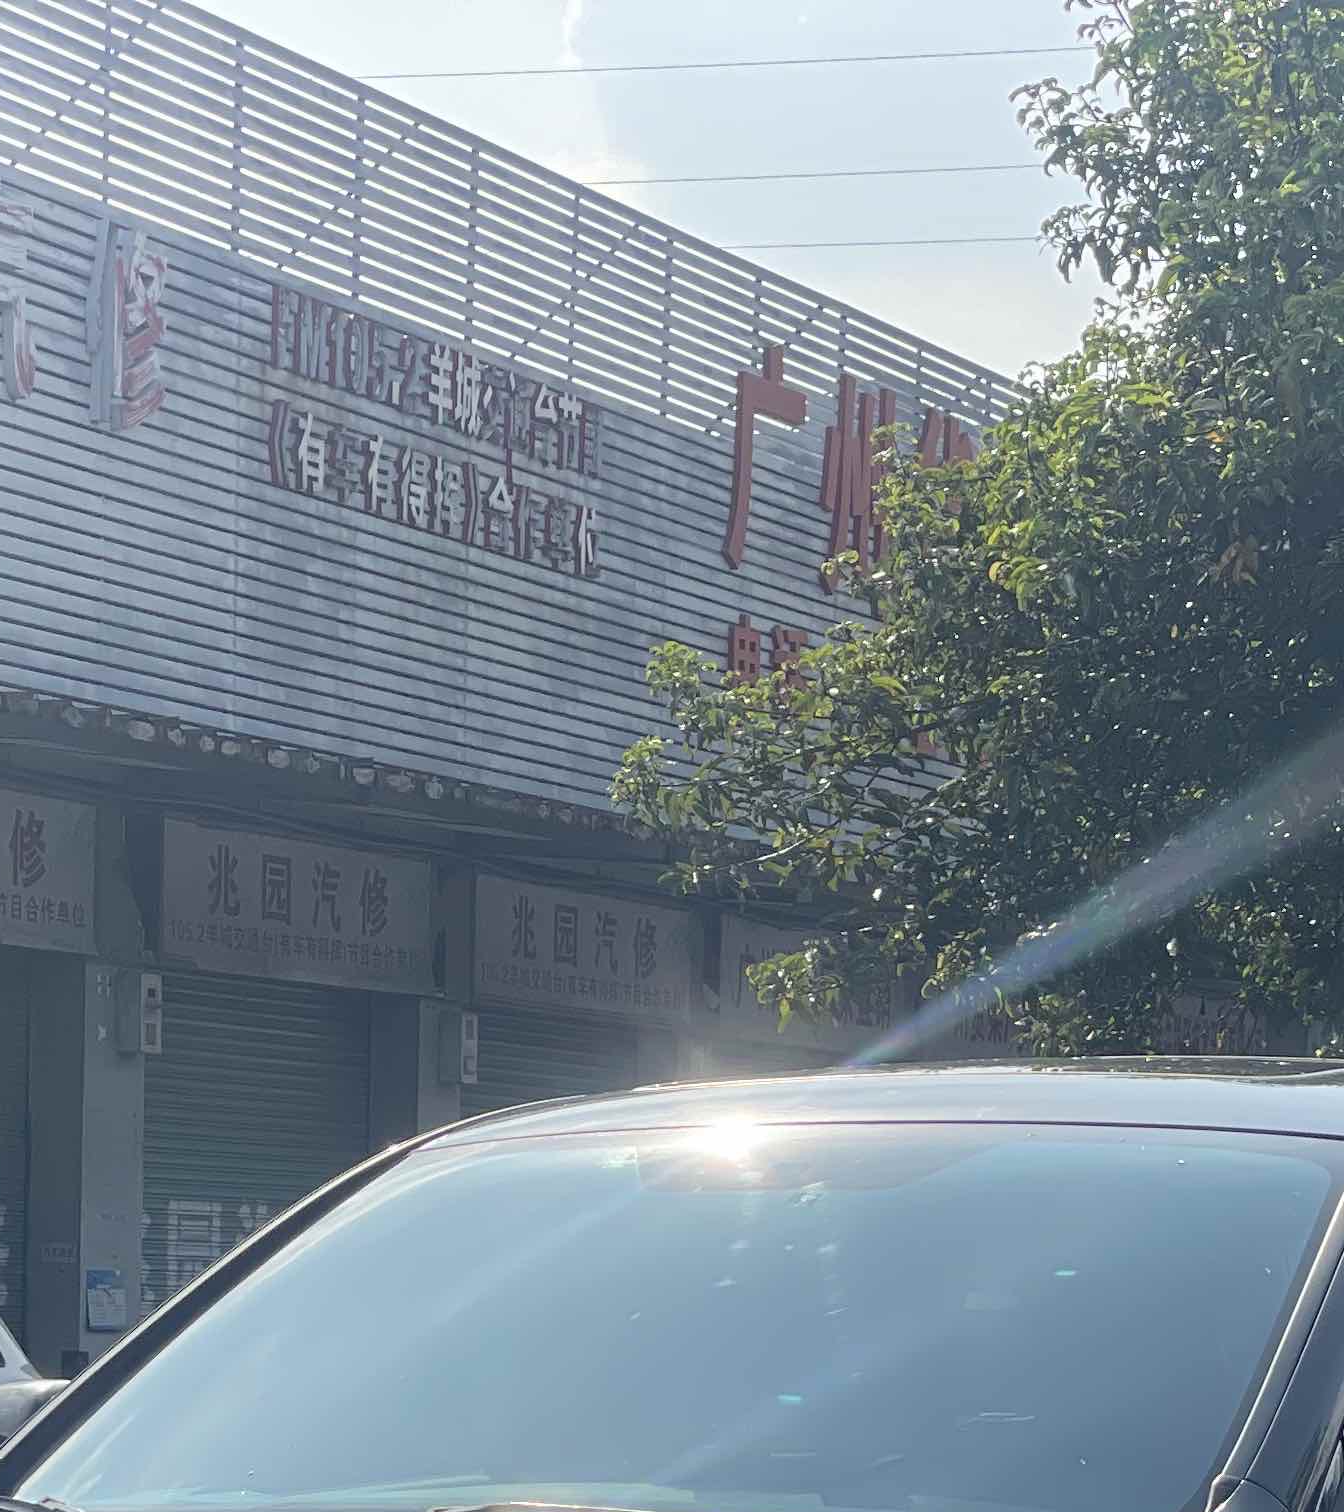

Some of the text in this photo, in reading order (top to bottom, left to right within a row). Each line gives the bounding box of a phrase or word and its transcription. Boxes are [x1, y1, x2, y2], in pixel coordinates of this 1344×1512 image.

[207, 841, 391, 938] 兆园汽修
[511, 892, 658, 979] 兆园汽修
